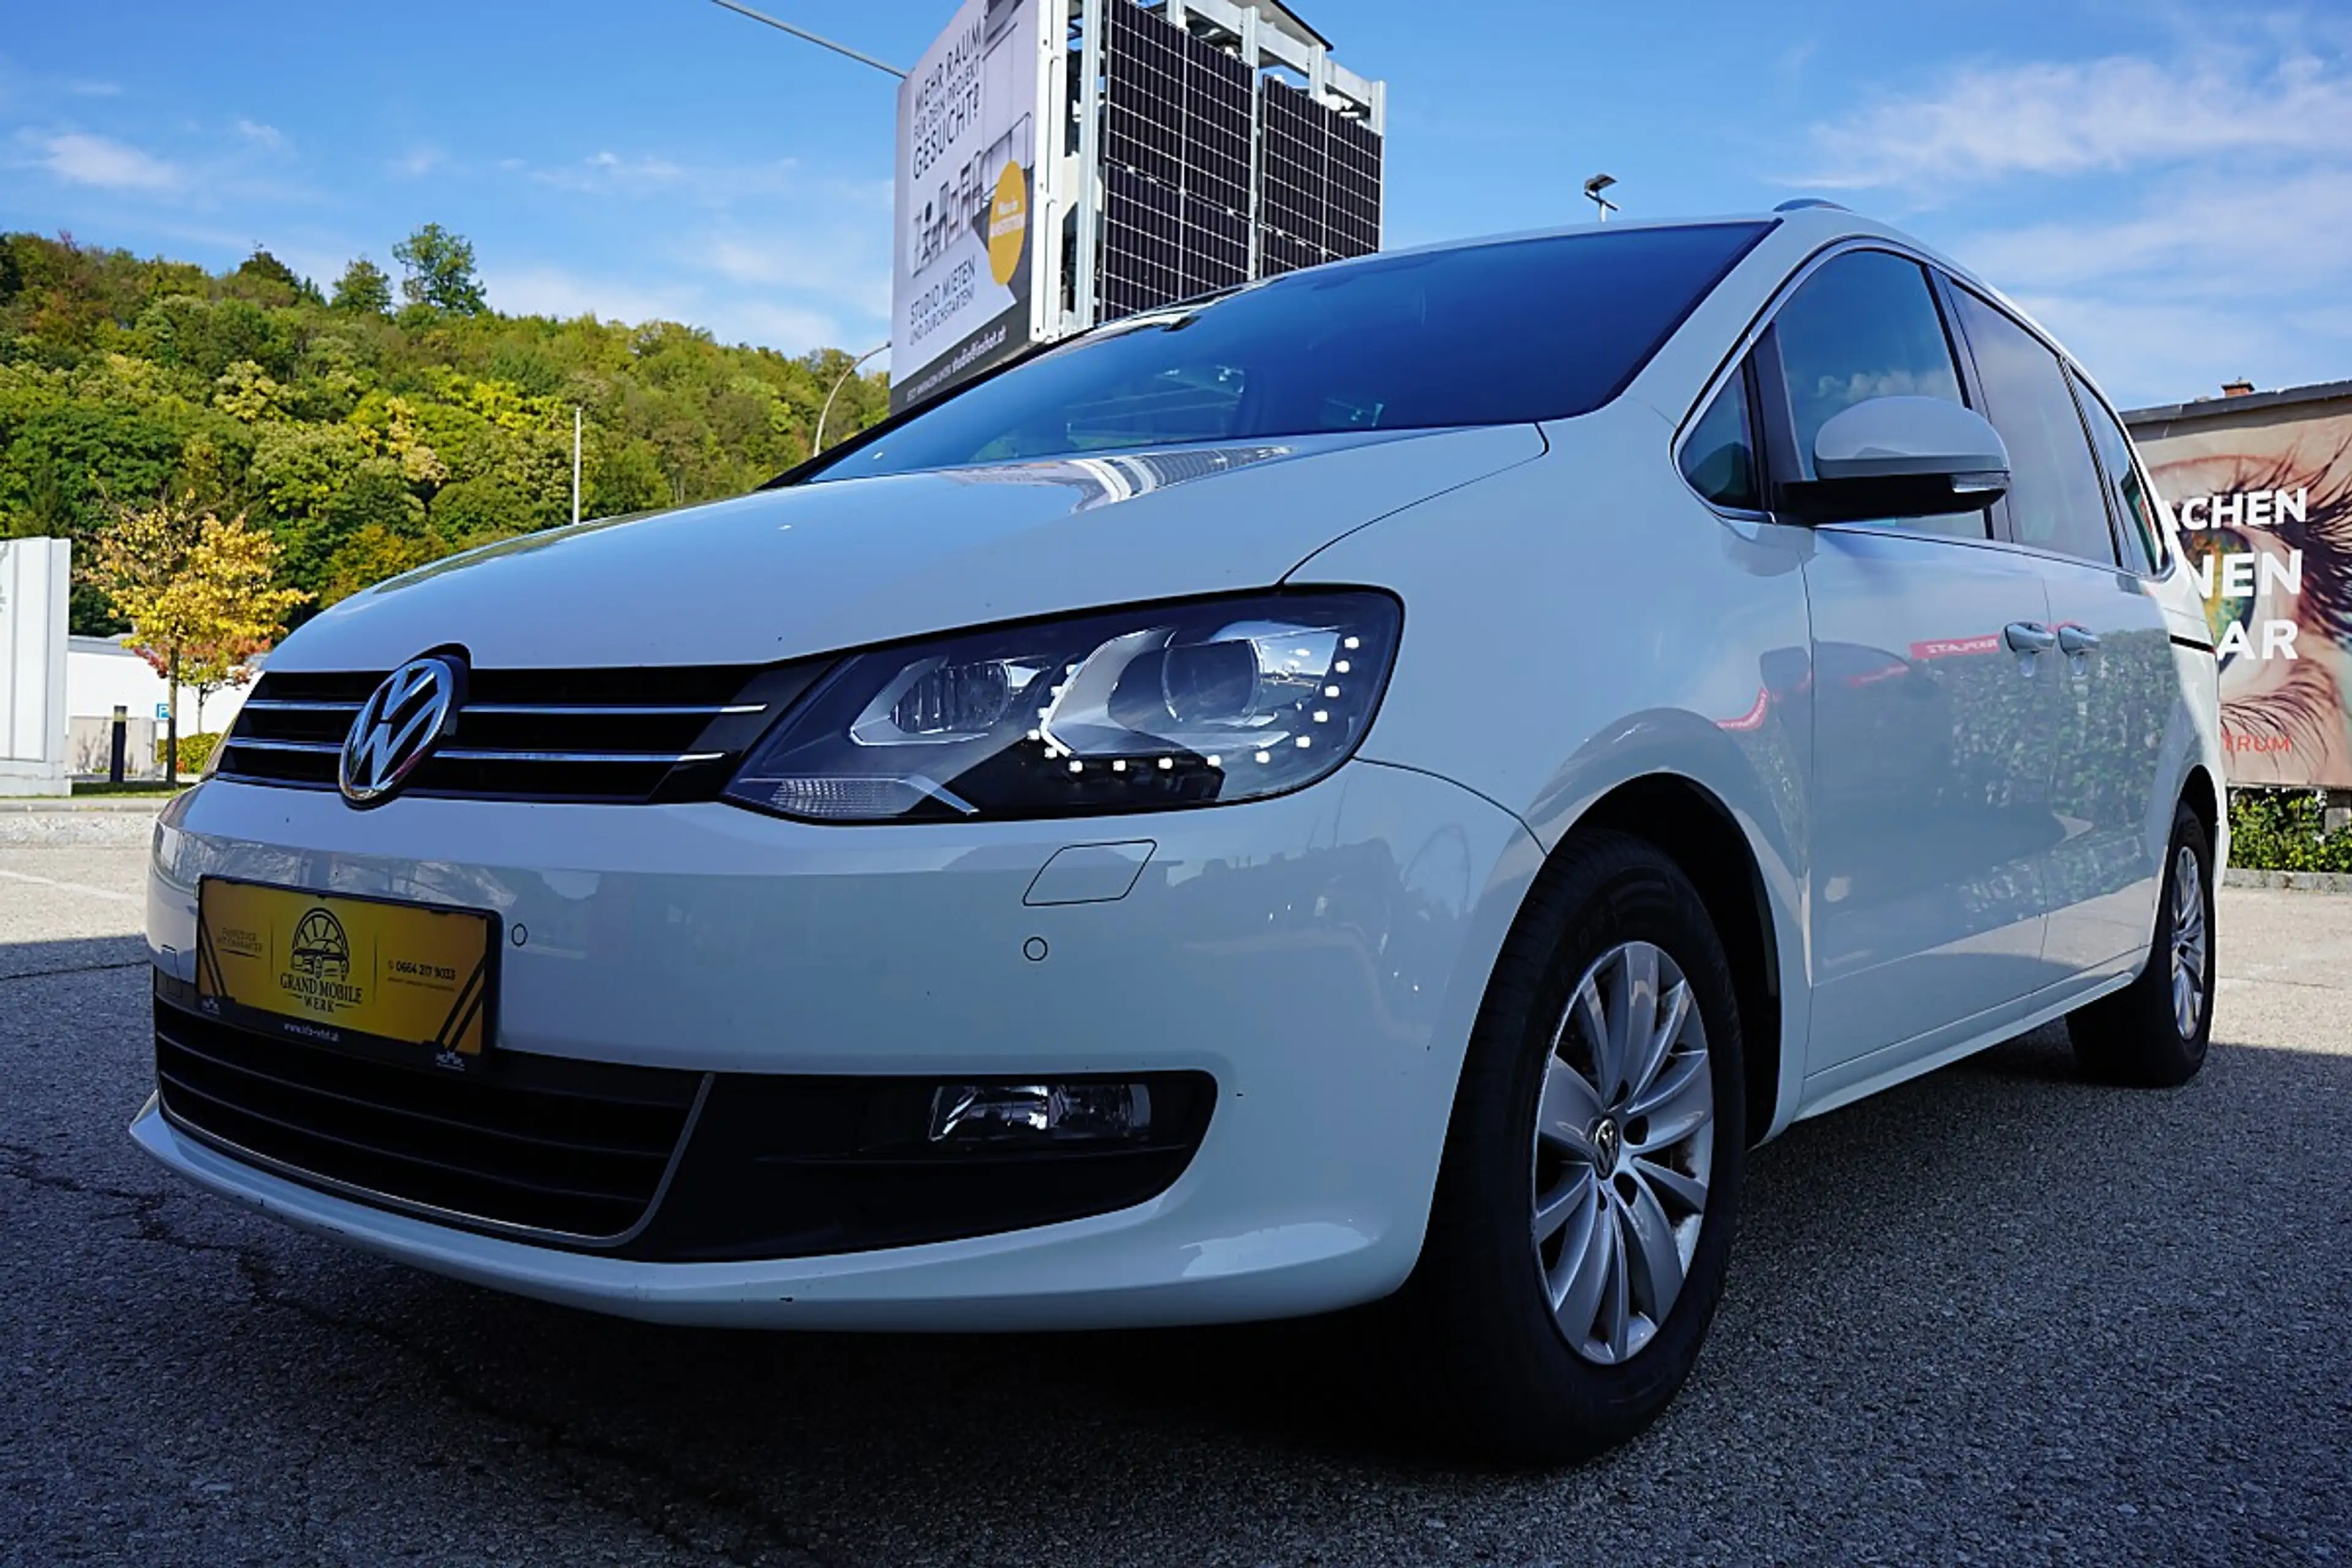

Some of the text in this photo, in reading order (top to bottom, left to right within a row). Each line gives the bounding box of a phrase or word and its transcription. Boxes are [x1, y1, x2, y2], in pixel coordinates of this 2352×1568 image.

[914, 16, 981, 119] MEHR RAUM
[948, 55, 980, 105] PROJEKT
[913, 83, 979, 179] GESUCHT?
[911, 255, 975, 325] STUDIO MIETEN
[280, 972, 318, 994] GRAND
[318, 981, 363, 1004] MOBILE
[304, 994, 334, 1012] WERK
